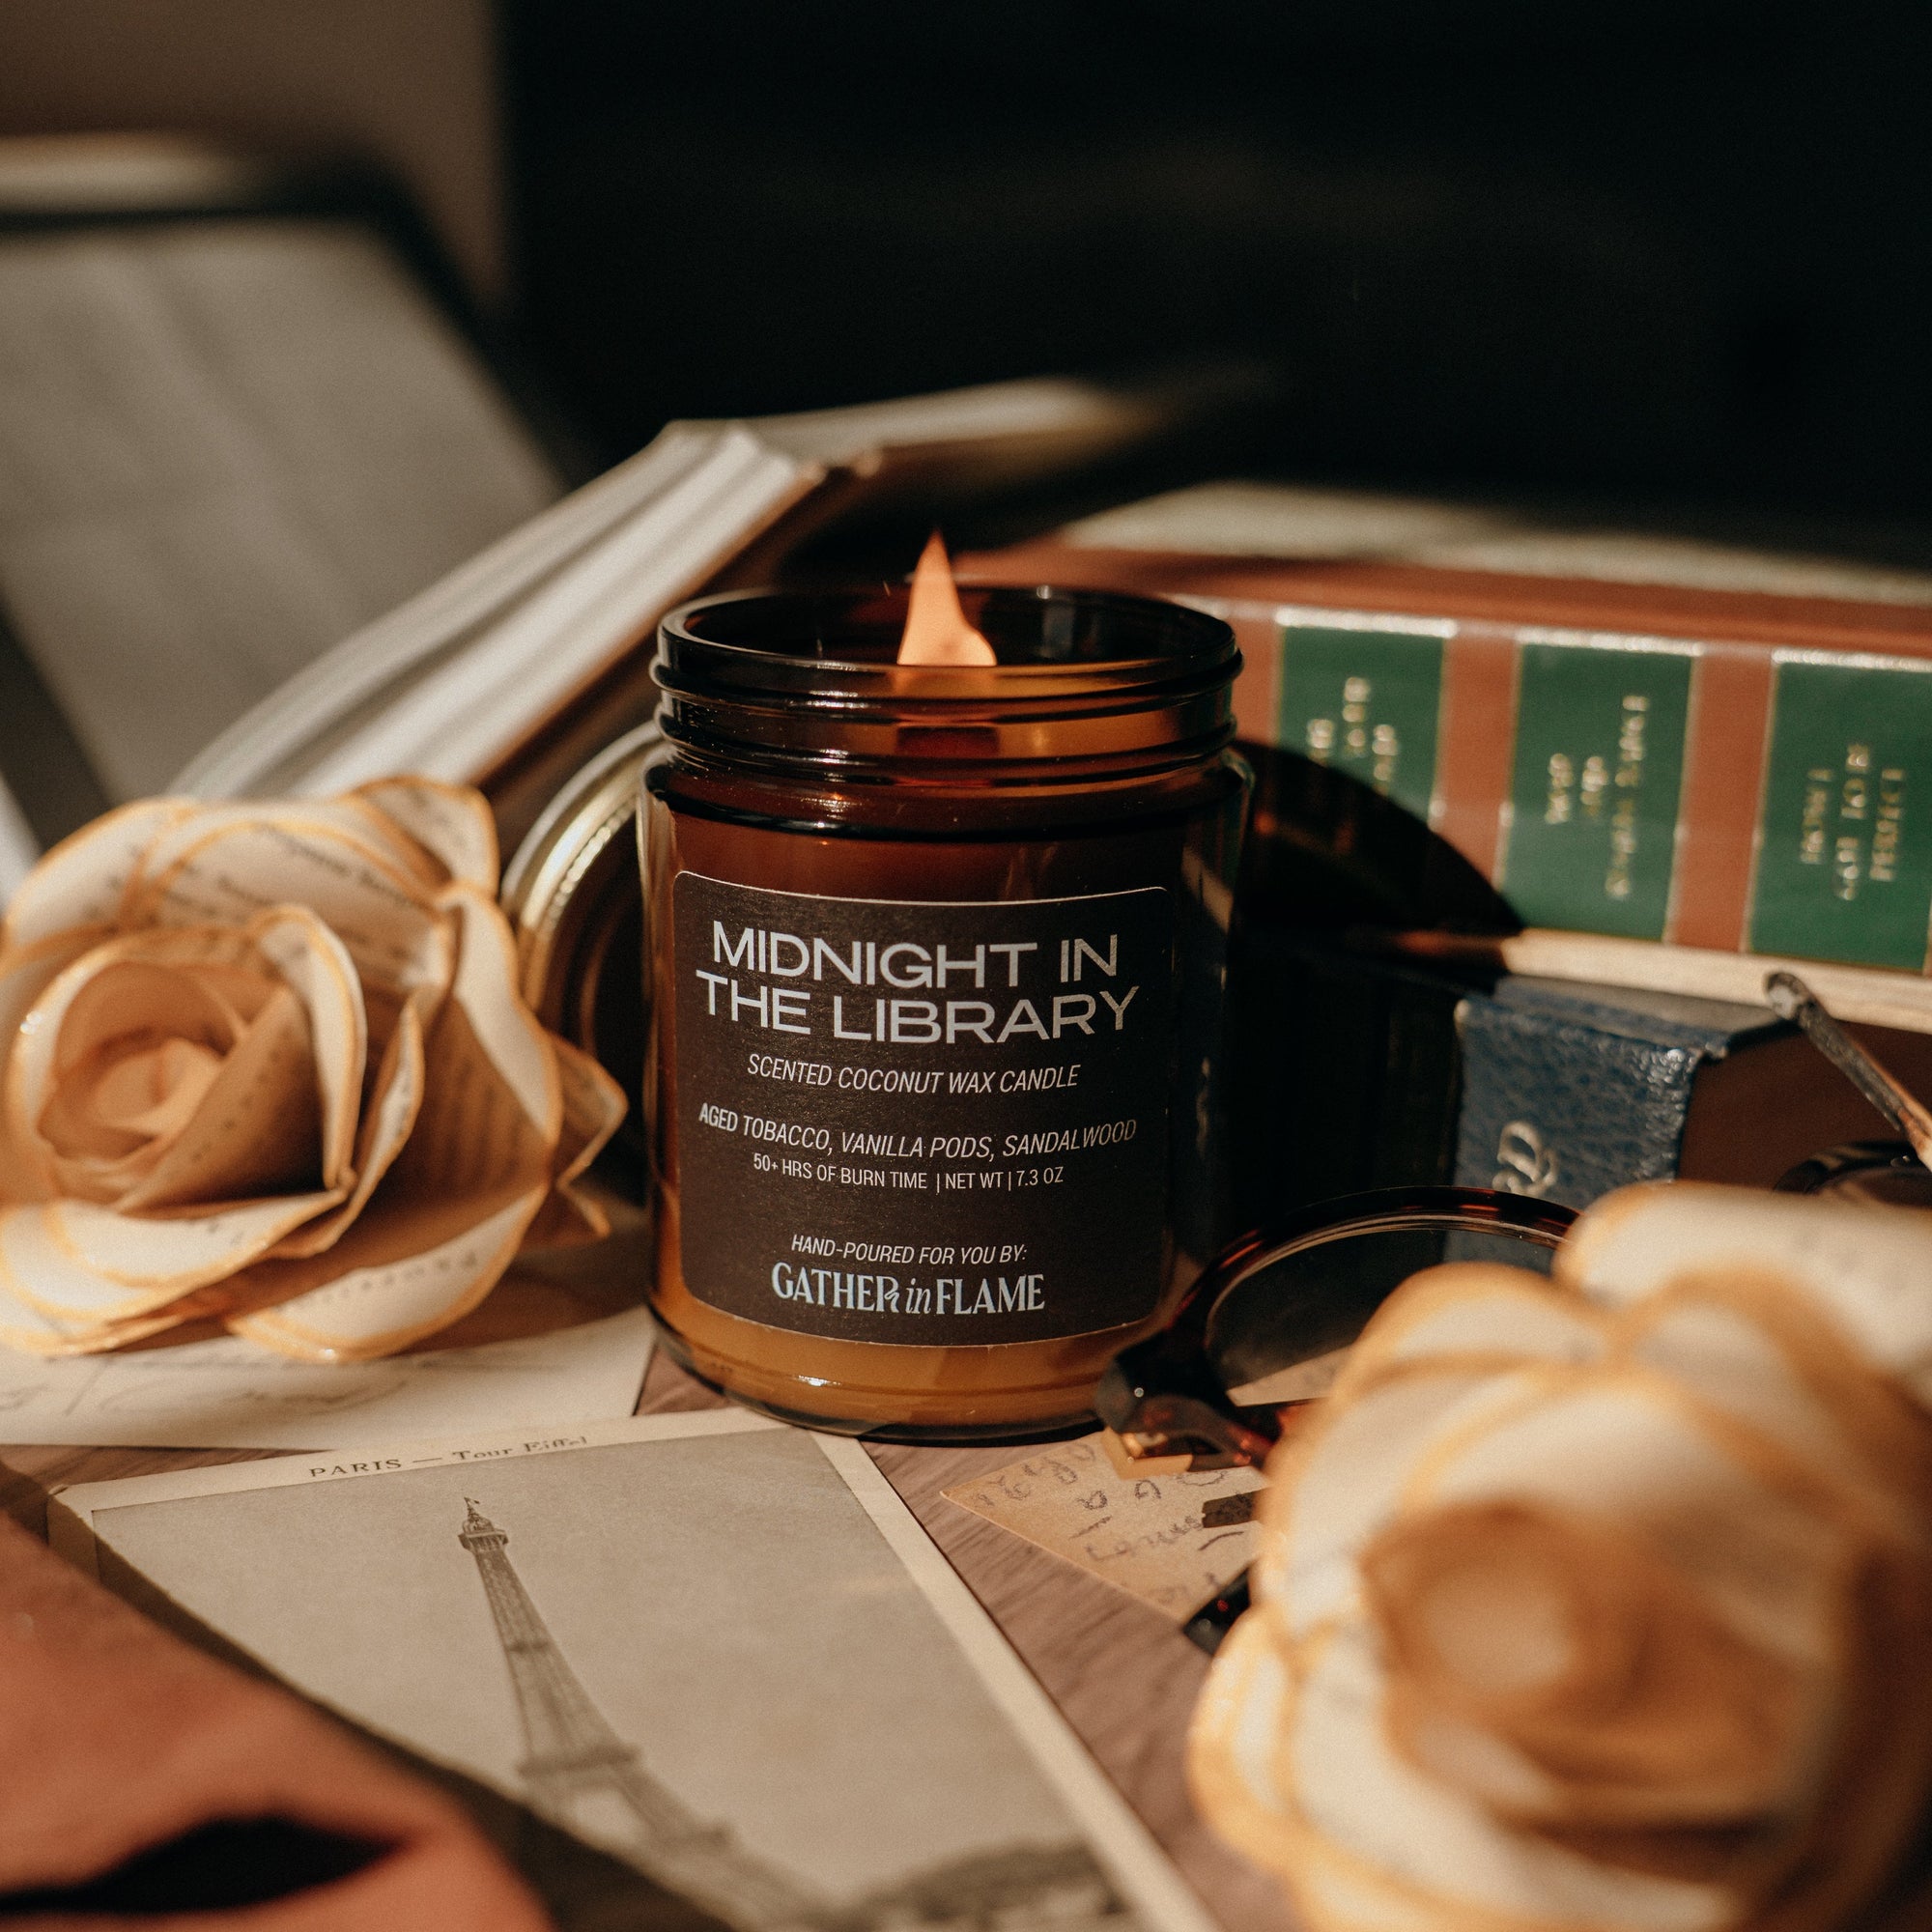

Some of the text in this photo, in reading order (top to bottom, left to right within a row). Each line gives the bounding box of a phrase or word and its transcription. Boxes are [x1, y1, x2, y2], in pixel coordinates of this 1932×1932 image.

[713, 920, 1118, 989] MIDNIGHT IN
[696, 969, 1141, 1044] THE LIBRARY
[747, 1053, 1081, 1094] SCENTED COCONUT WAX CANDLE
[698, 1101, 1137, 1163] AGED TOBACCO, VANILLA PODS, SANDALWOOD
[753, 1151, 779, 1173] 50+
[781, 1158, 812, 1179] HRS
[816, 1164, 838, 1182] OF
[840, 1167, 886, 1187] BURN
[890, 1170, 928, 1189] TIME
[945, 1172, 976, 1190] NET
[979, 1171, 1005, 1190] WT
[1016, 1169, 1039, 1187] 7.3
[1043, 1165, 1065, 1184] OZ
[790, 1234, 1029, 1265] HAND-POURED FOR YOU BY:
[771, 1261, 1046, 1316] GATHER in FLAME
[309, 1458, 403, 1478] PARIS
[452, 1448, 514, 1462] Tour
